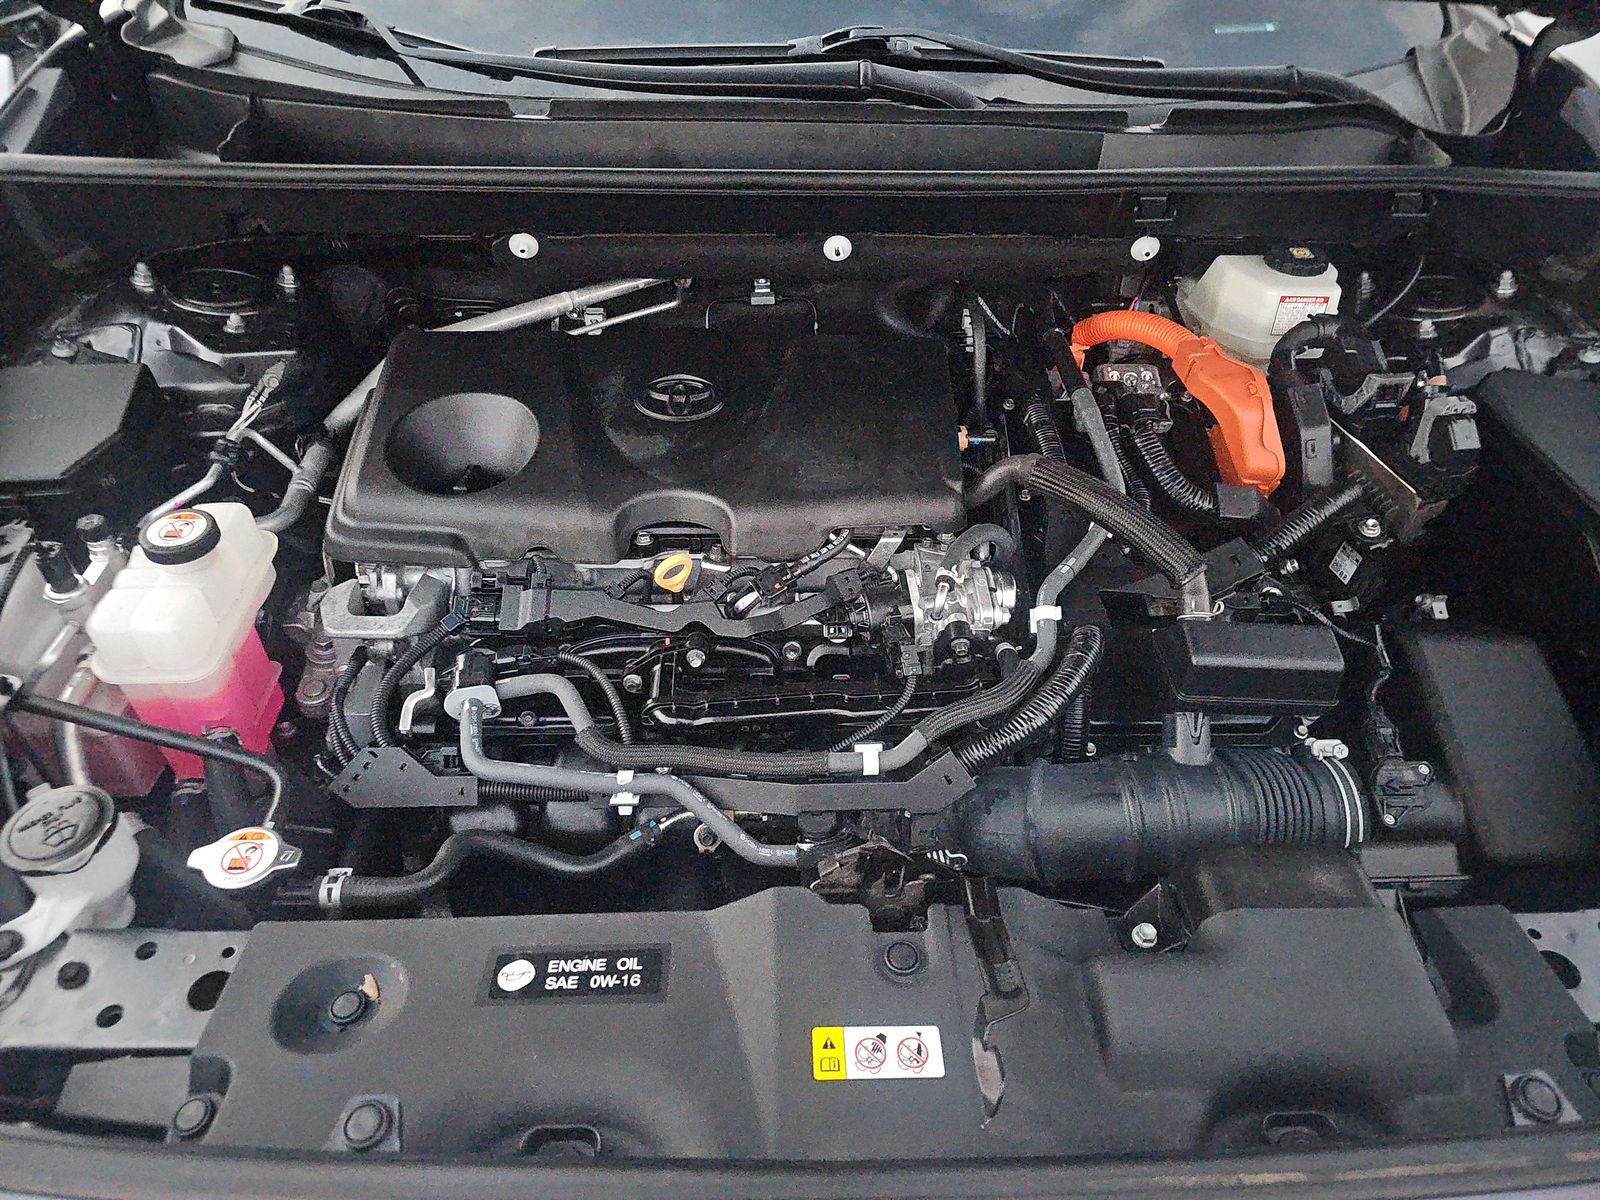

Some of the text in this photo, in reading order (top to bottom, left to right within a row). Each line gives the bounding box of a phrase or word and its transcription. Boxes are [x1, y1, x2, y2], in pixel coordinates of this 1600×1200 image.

[547, 957, 643, 973] ENGINE OIL
[544, 974, 642, 990] SAE 0W-16
